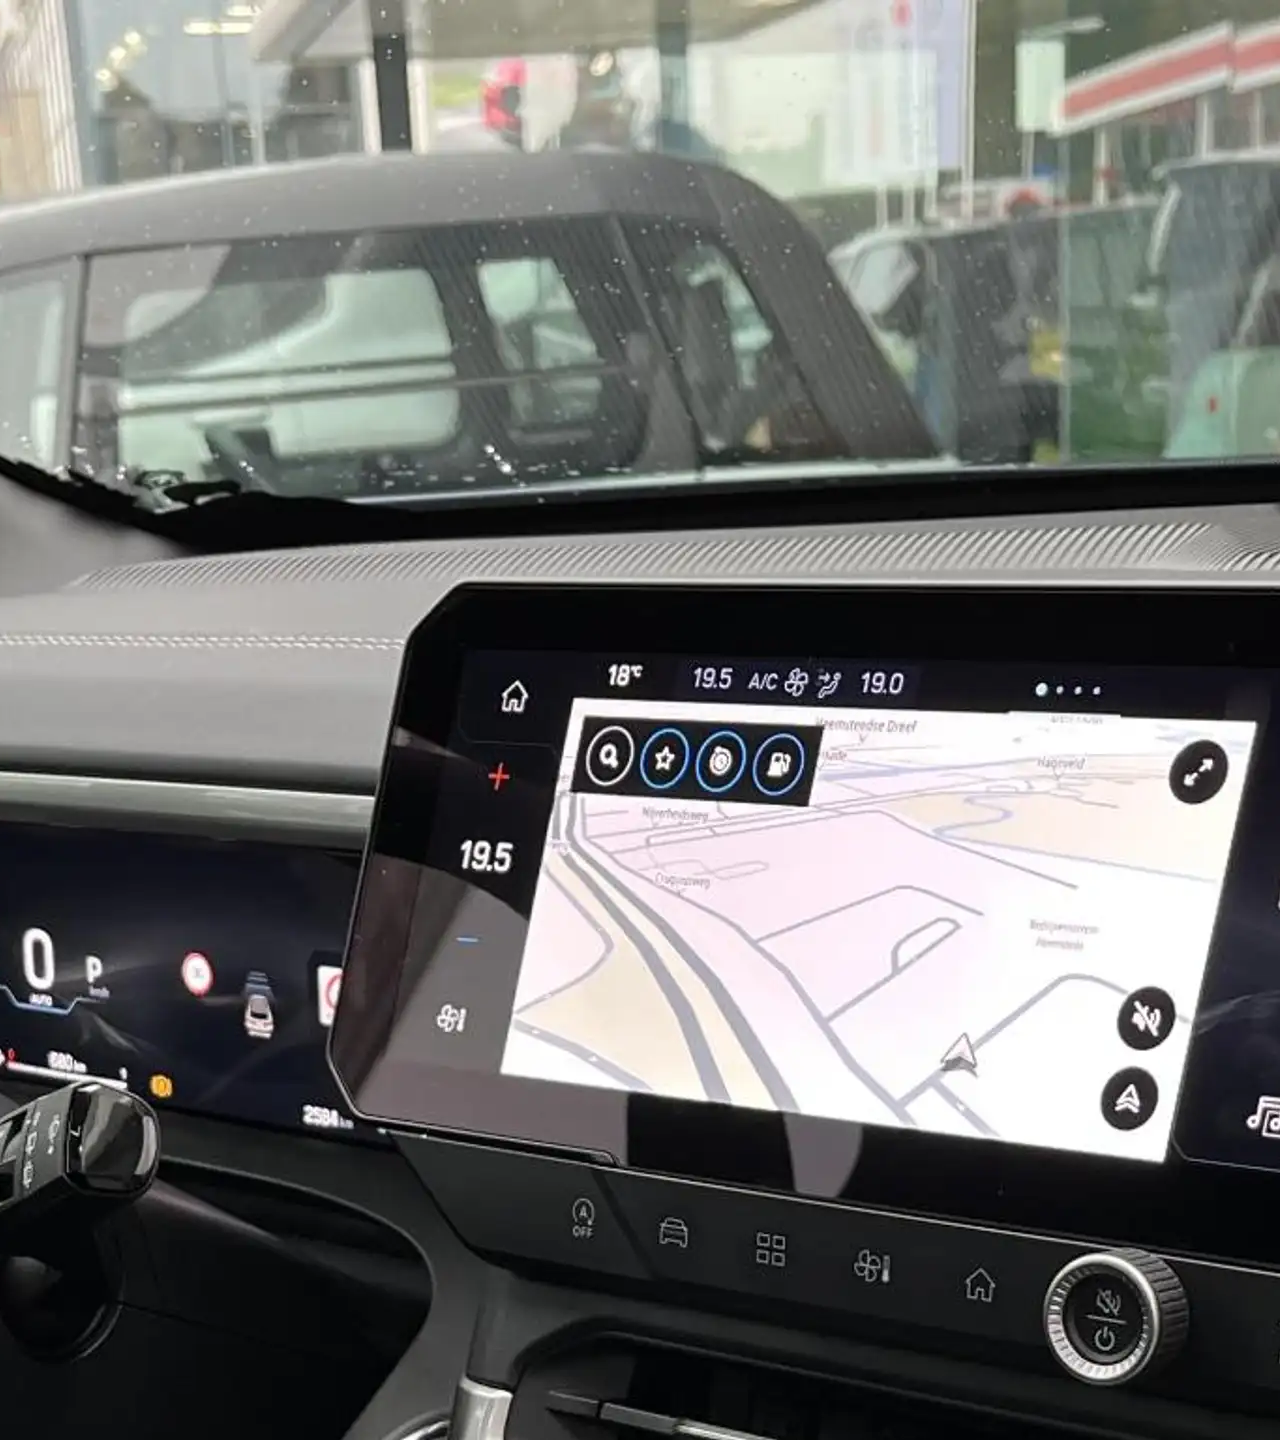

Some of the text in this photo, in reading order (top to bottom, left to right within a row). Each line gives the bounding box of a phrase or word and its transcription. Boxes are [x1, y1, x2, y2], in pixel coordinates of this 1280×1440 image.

[693, 667, 905, 694] 19.5 A/C 19.0
[460, 839, 514, 874] 19.5
[22, 927, 55, 990] 0
[85, 954, 103, 985] P
[572, 1224, 594, 1239] OFF
